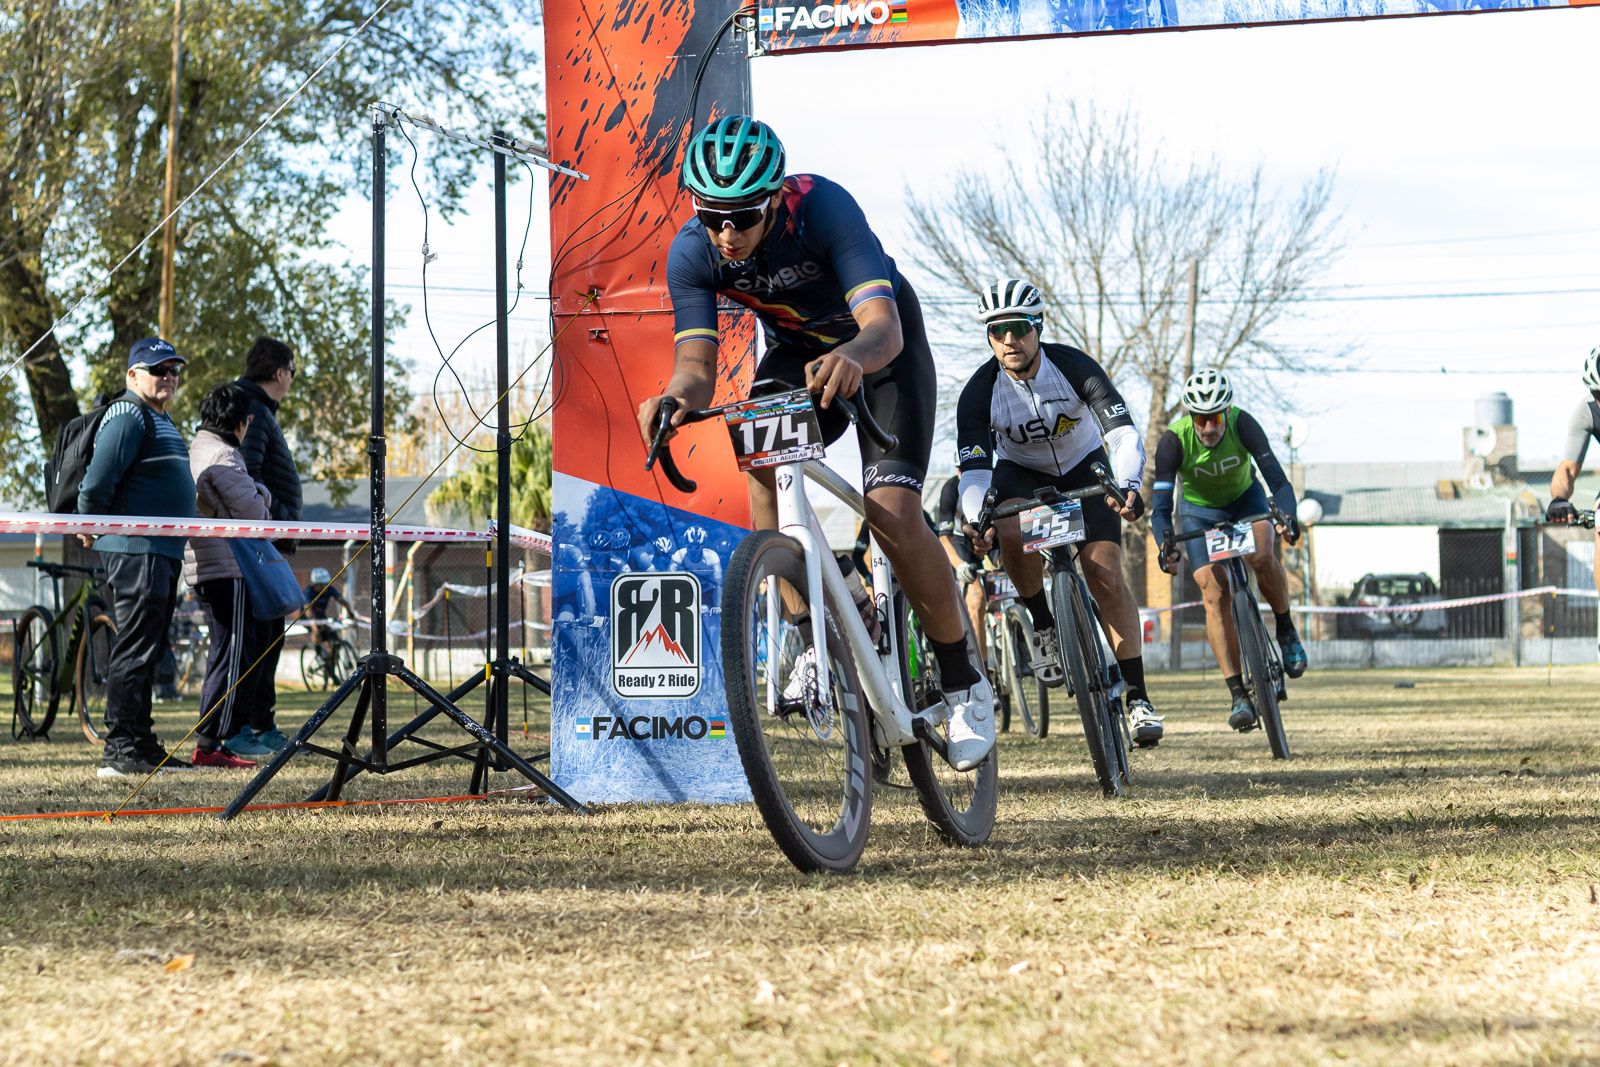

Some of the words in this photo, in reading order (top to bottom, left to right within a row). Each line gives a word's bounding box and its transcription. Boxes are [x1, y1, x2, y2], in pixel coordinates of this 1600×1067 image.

[775, 1, 890, 31] FACIMO
[738, 414, 809, 455] 174
[754, 457, 778, 466] MIGUEL
[780, 451, 808, 461] AGUILAR
[1194, 456, 1240, 478] NP
[1032, 512, 1071, 539] 45
[1211, 532, 1248, 553] 217
[618, 674, 655, 688] Ready
[658, 674, 666, 687] 2
[668, 674, 695, 687] Ride
[593, 715, 708, 740] FACIMO
